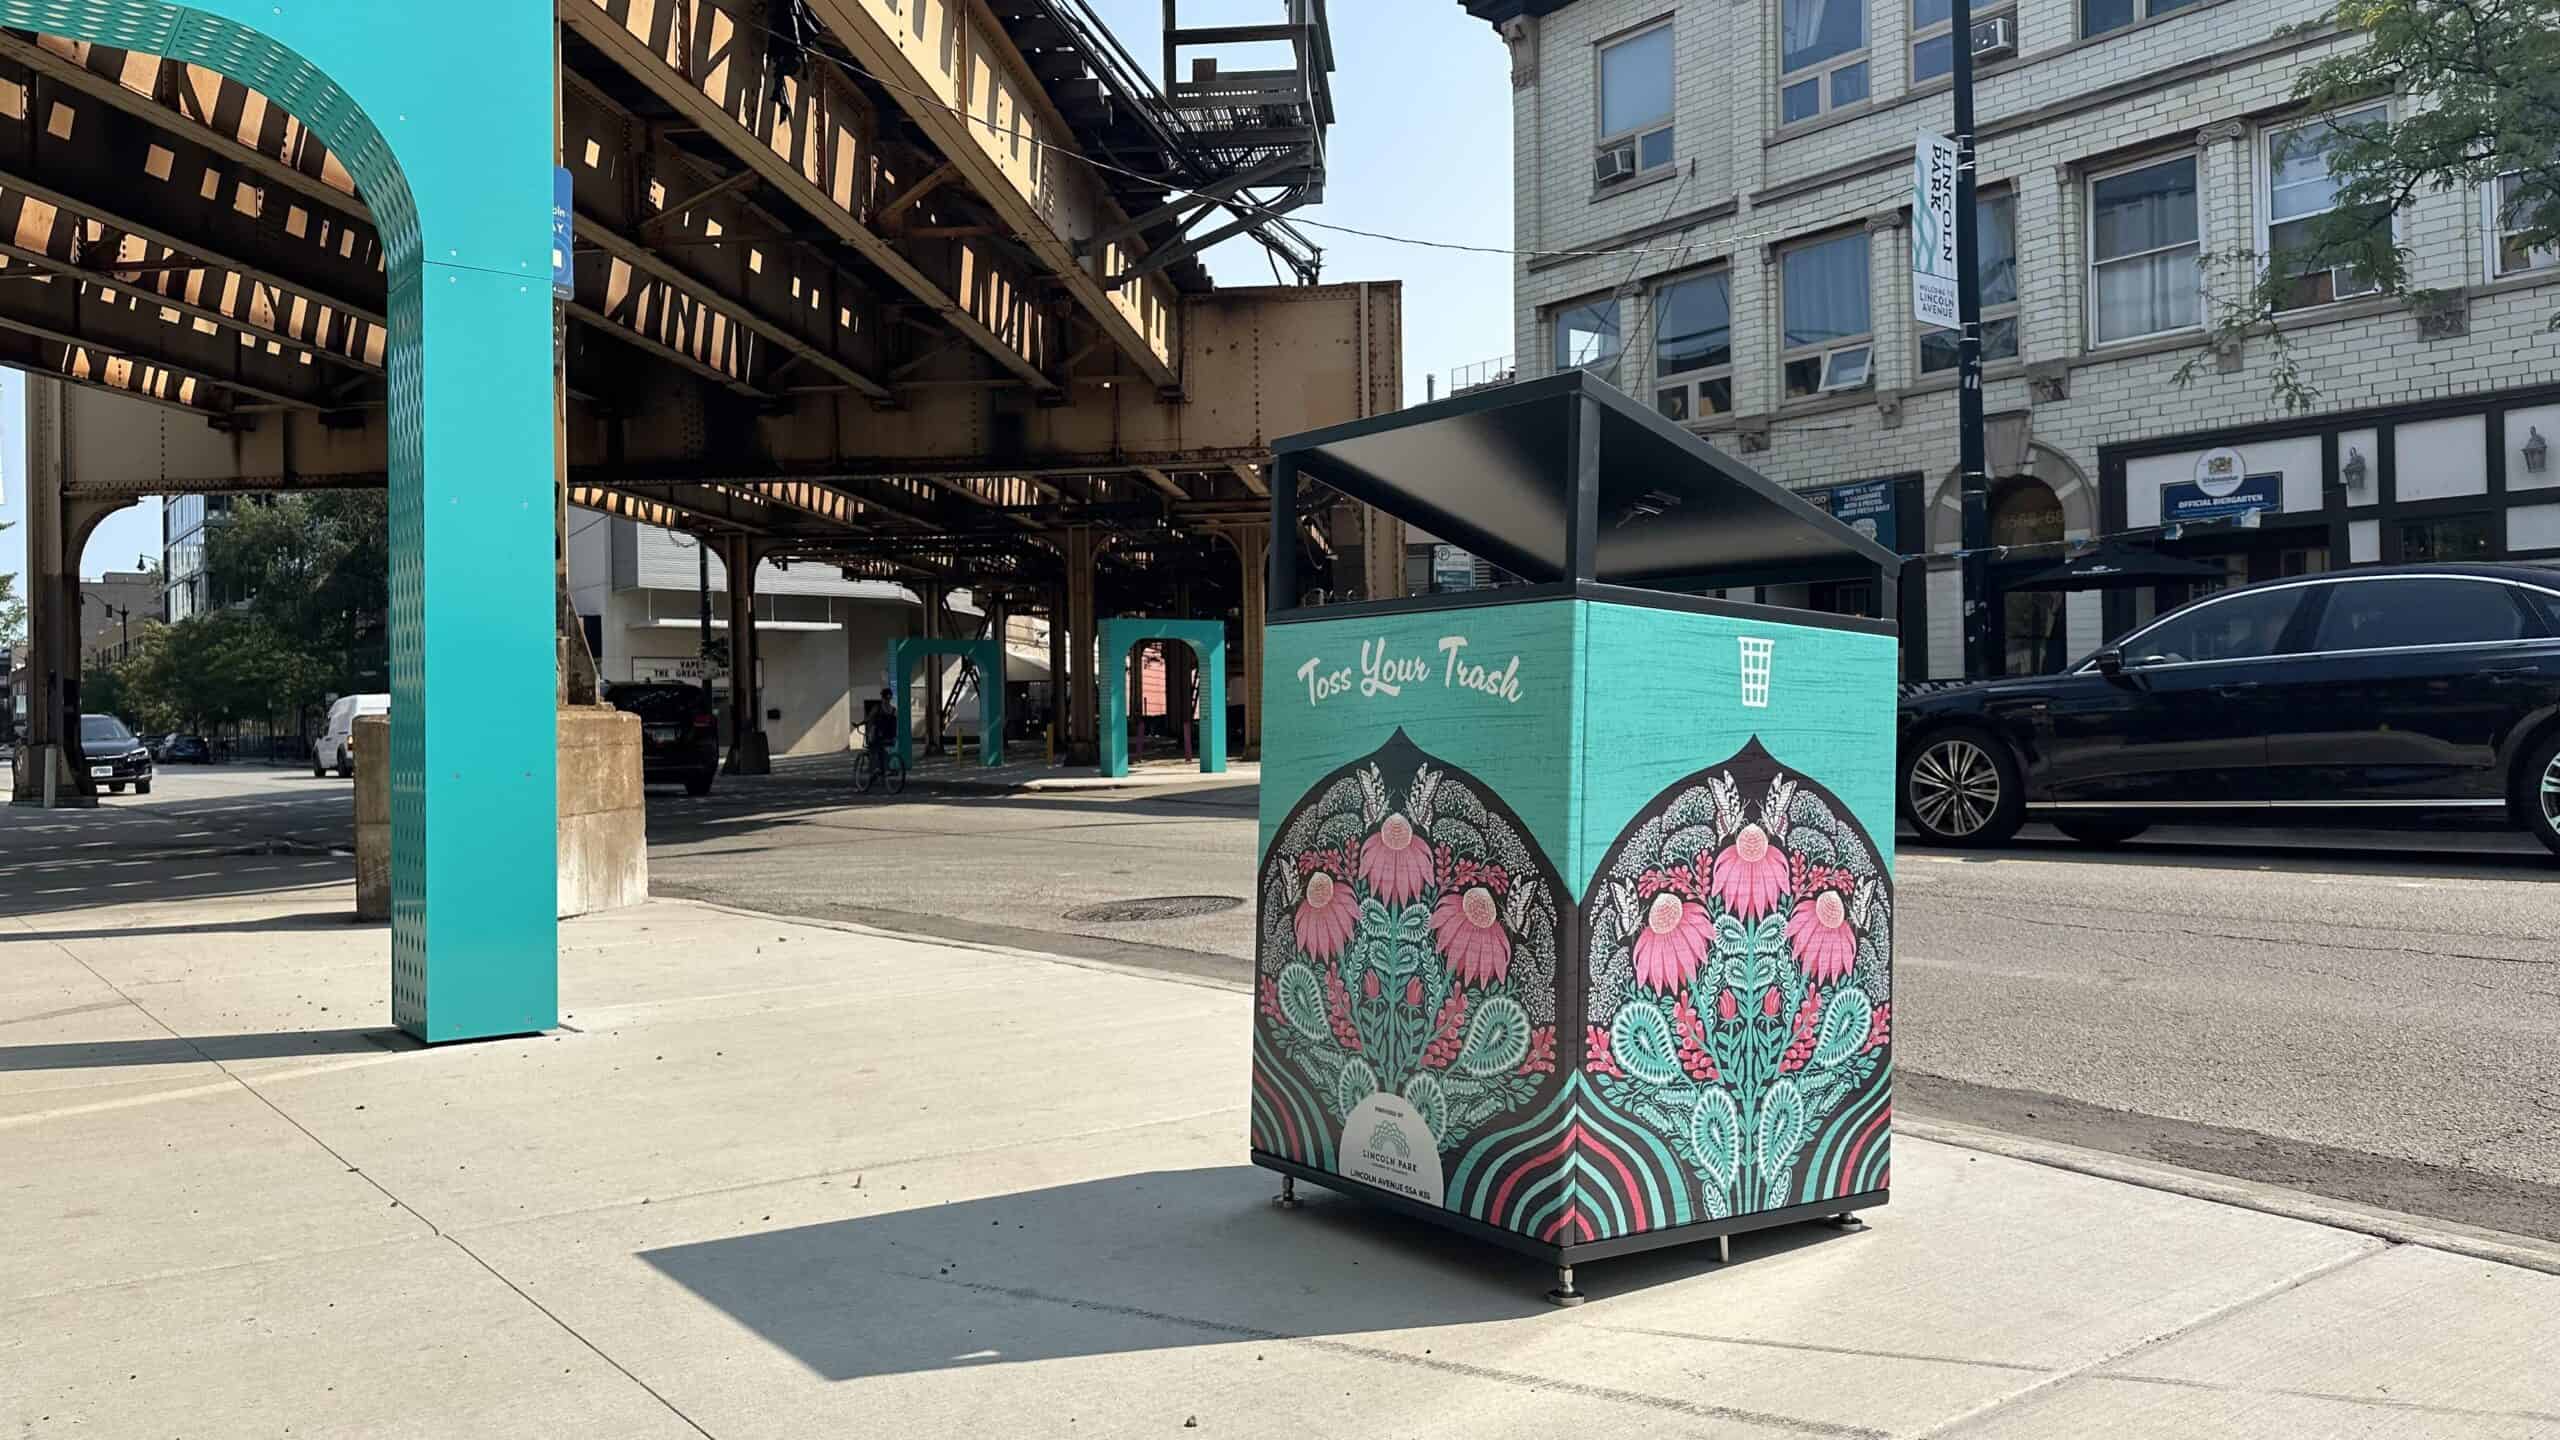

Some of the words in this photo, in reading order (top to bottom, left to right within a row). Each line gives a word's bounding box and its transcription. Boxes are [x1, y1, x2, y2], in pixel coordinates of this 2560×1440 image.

[1931, 144, 1941, 211] PARK
[1943, 148, 1952, 263] LINCOLN
[1920, 292, 1954, 307] LINCOLN
[1922, 303, 1953, 318] AVENUE
[2178, 499, 2211, 508] OFFICIAL
[1297, 657, 1351, 707] Toss
[1360, 637, 1430, 696] Your
[1438, 636, 1523, 703] Trash
[1362, 1149, 1395, 1165] LINCOLN
[1398, 1159, 1417, 1172] PARK
[1351, 1168, 1377, 1183] LINCOLN
[1378, 1178, 1403, 1191] AVENUE
[1405, 1185, 1417, 1196] SSA
